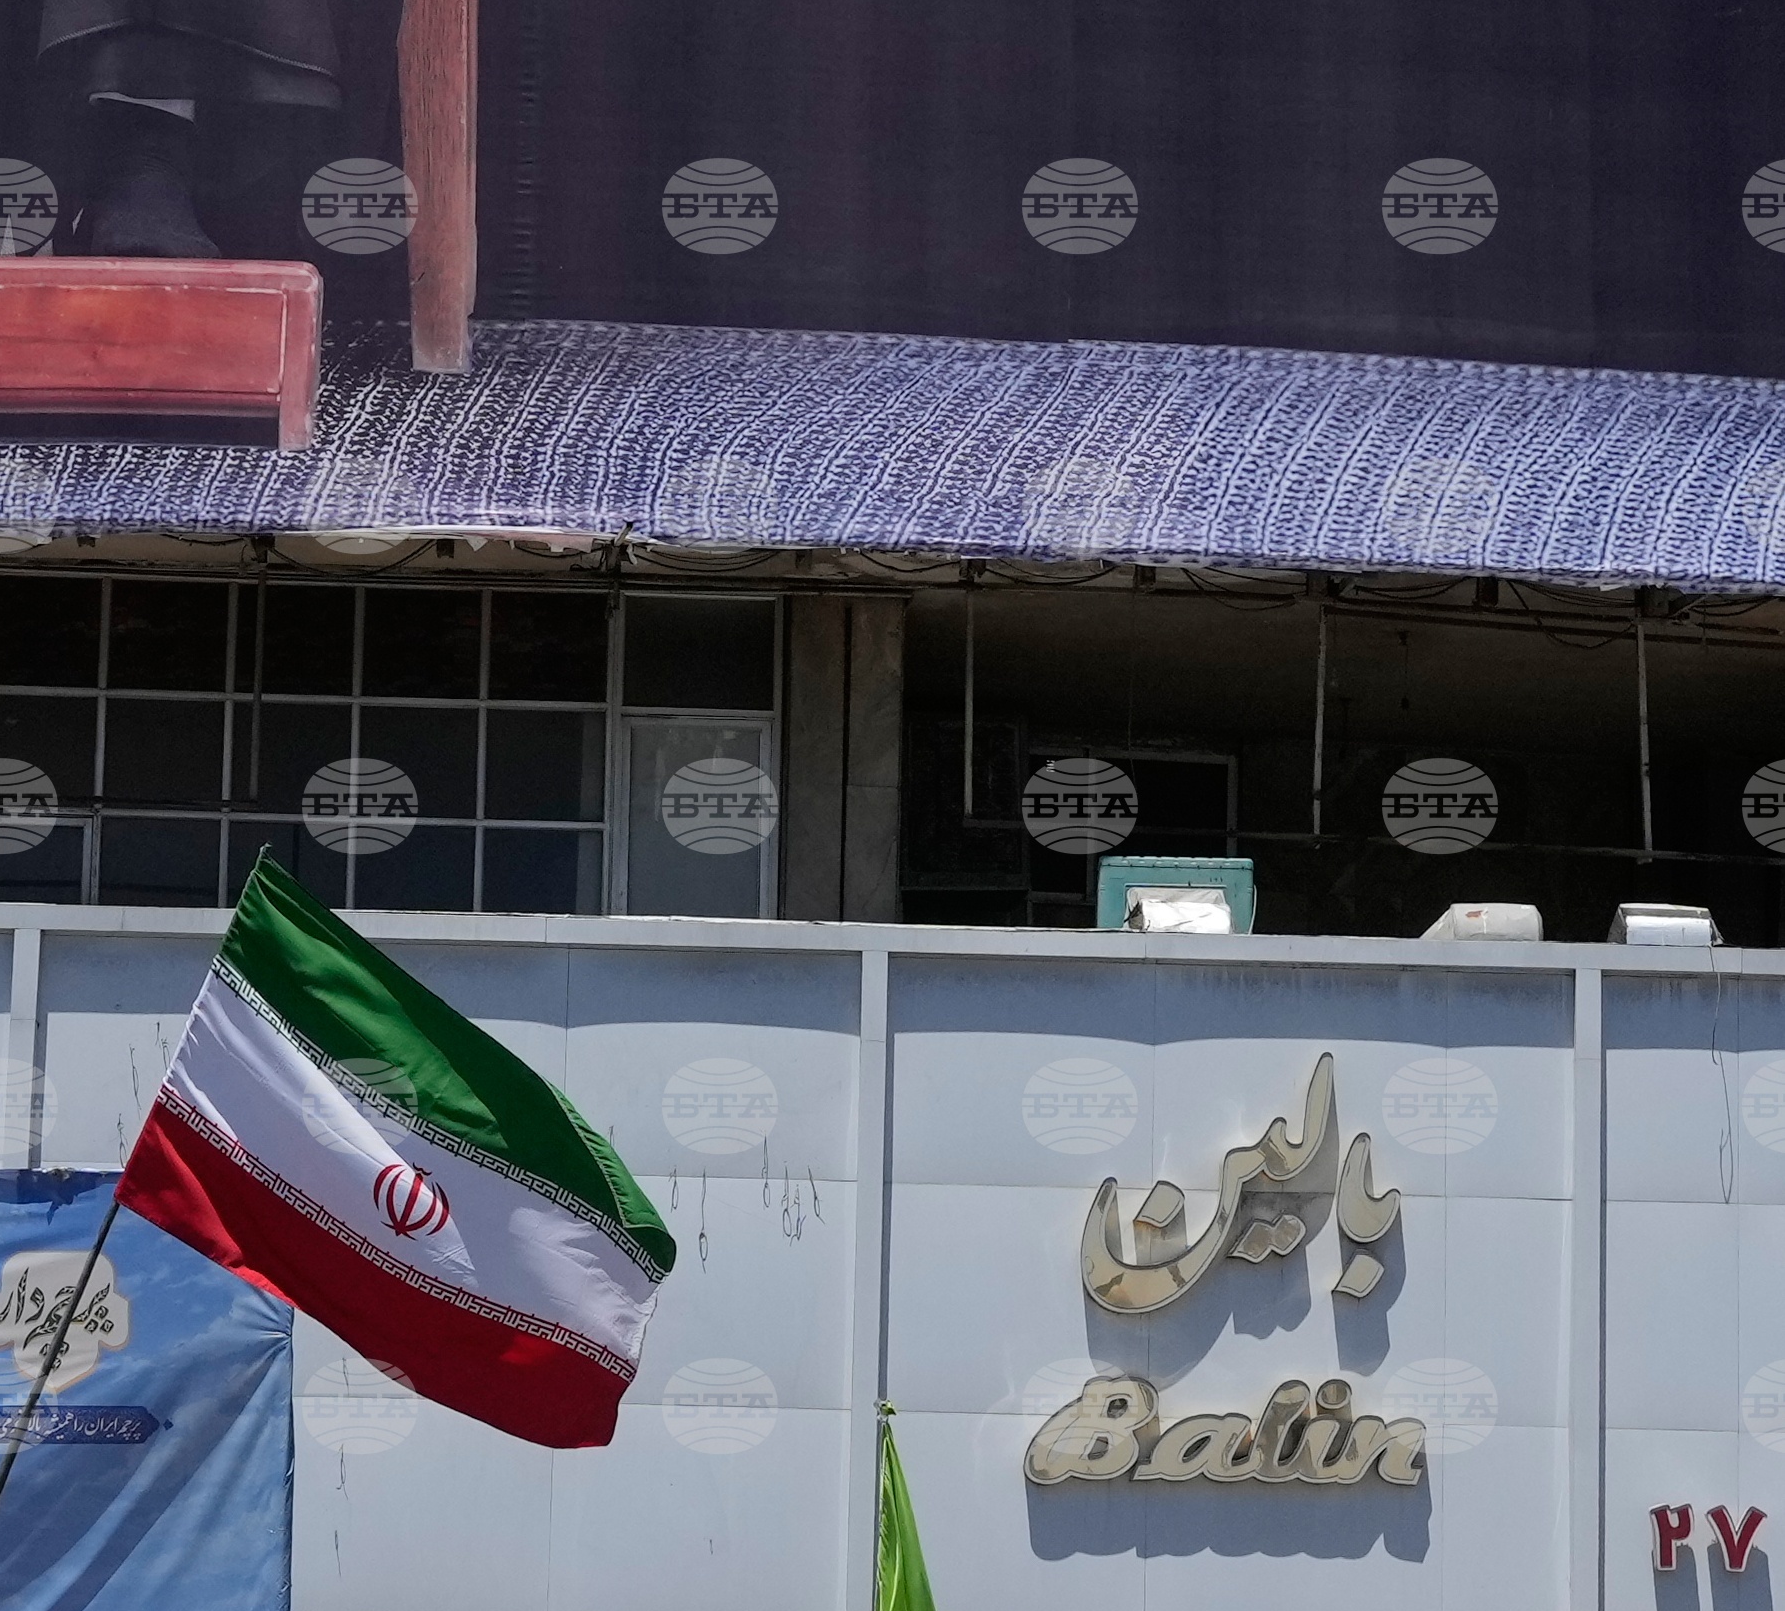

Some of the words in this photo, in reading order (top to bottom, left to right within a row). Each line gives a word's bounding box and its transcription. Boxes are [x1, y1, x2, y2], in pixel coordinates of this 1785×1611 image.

[1080, 1052, 1401, 1315] بالین
[1023, 1375, 1427, 1488] Balin
[1650, 1504, 1767, 1573] ۲۷
